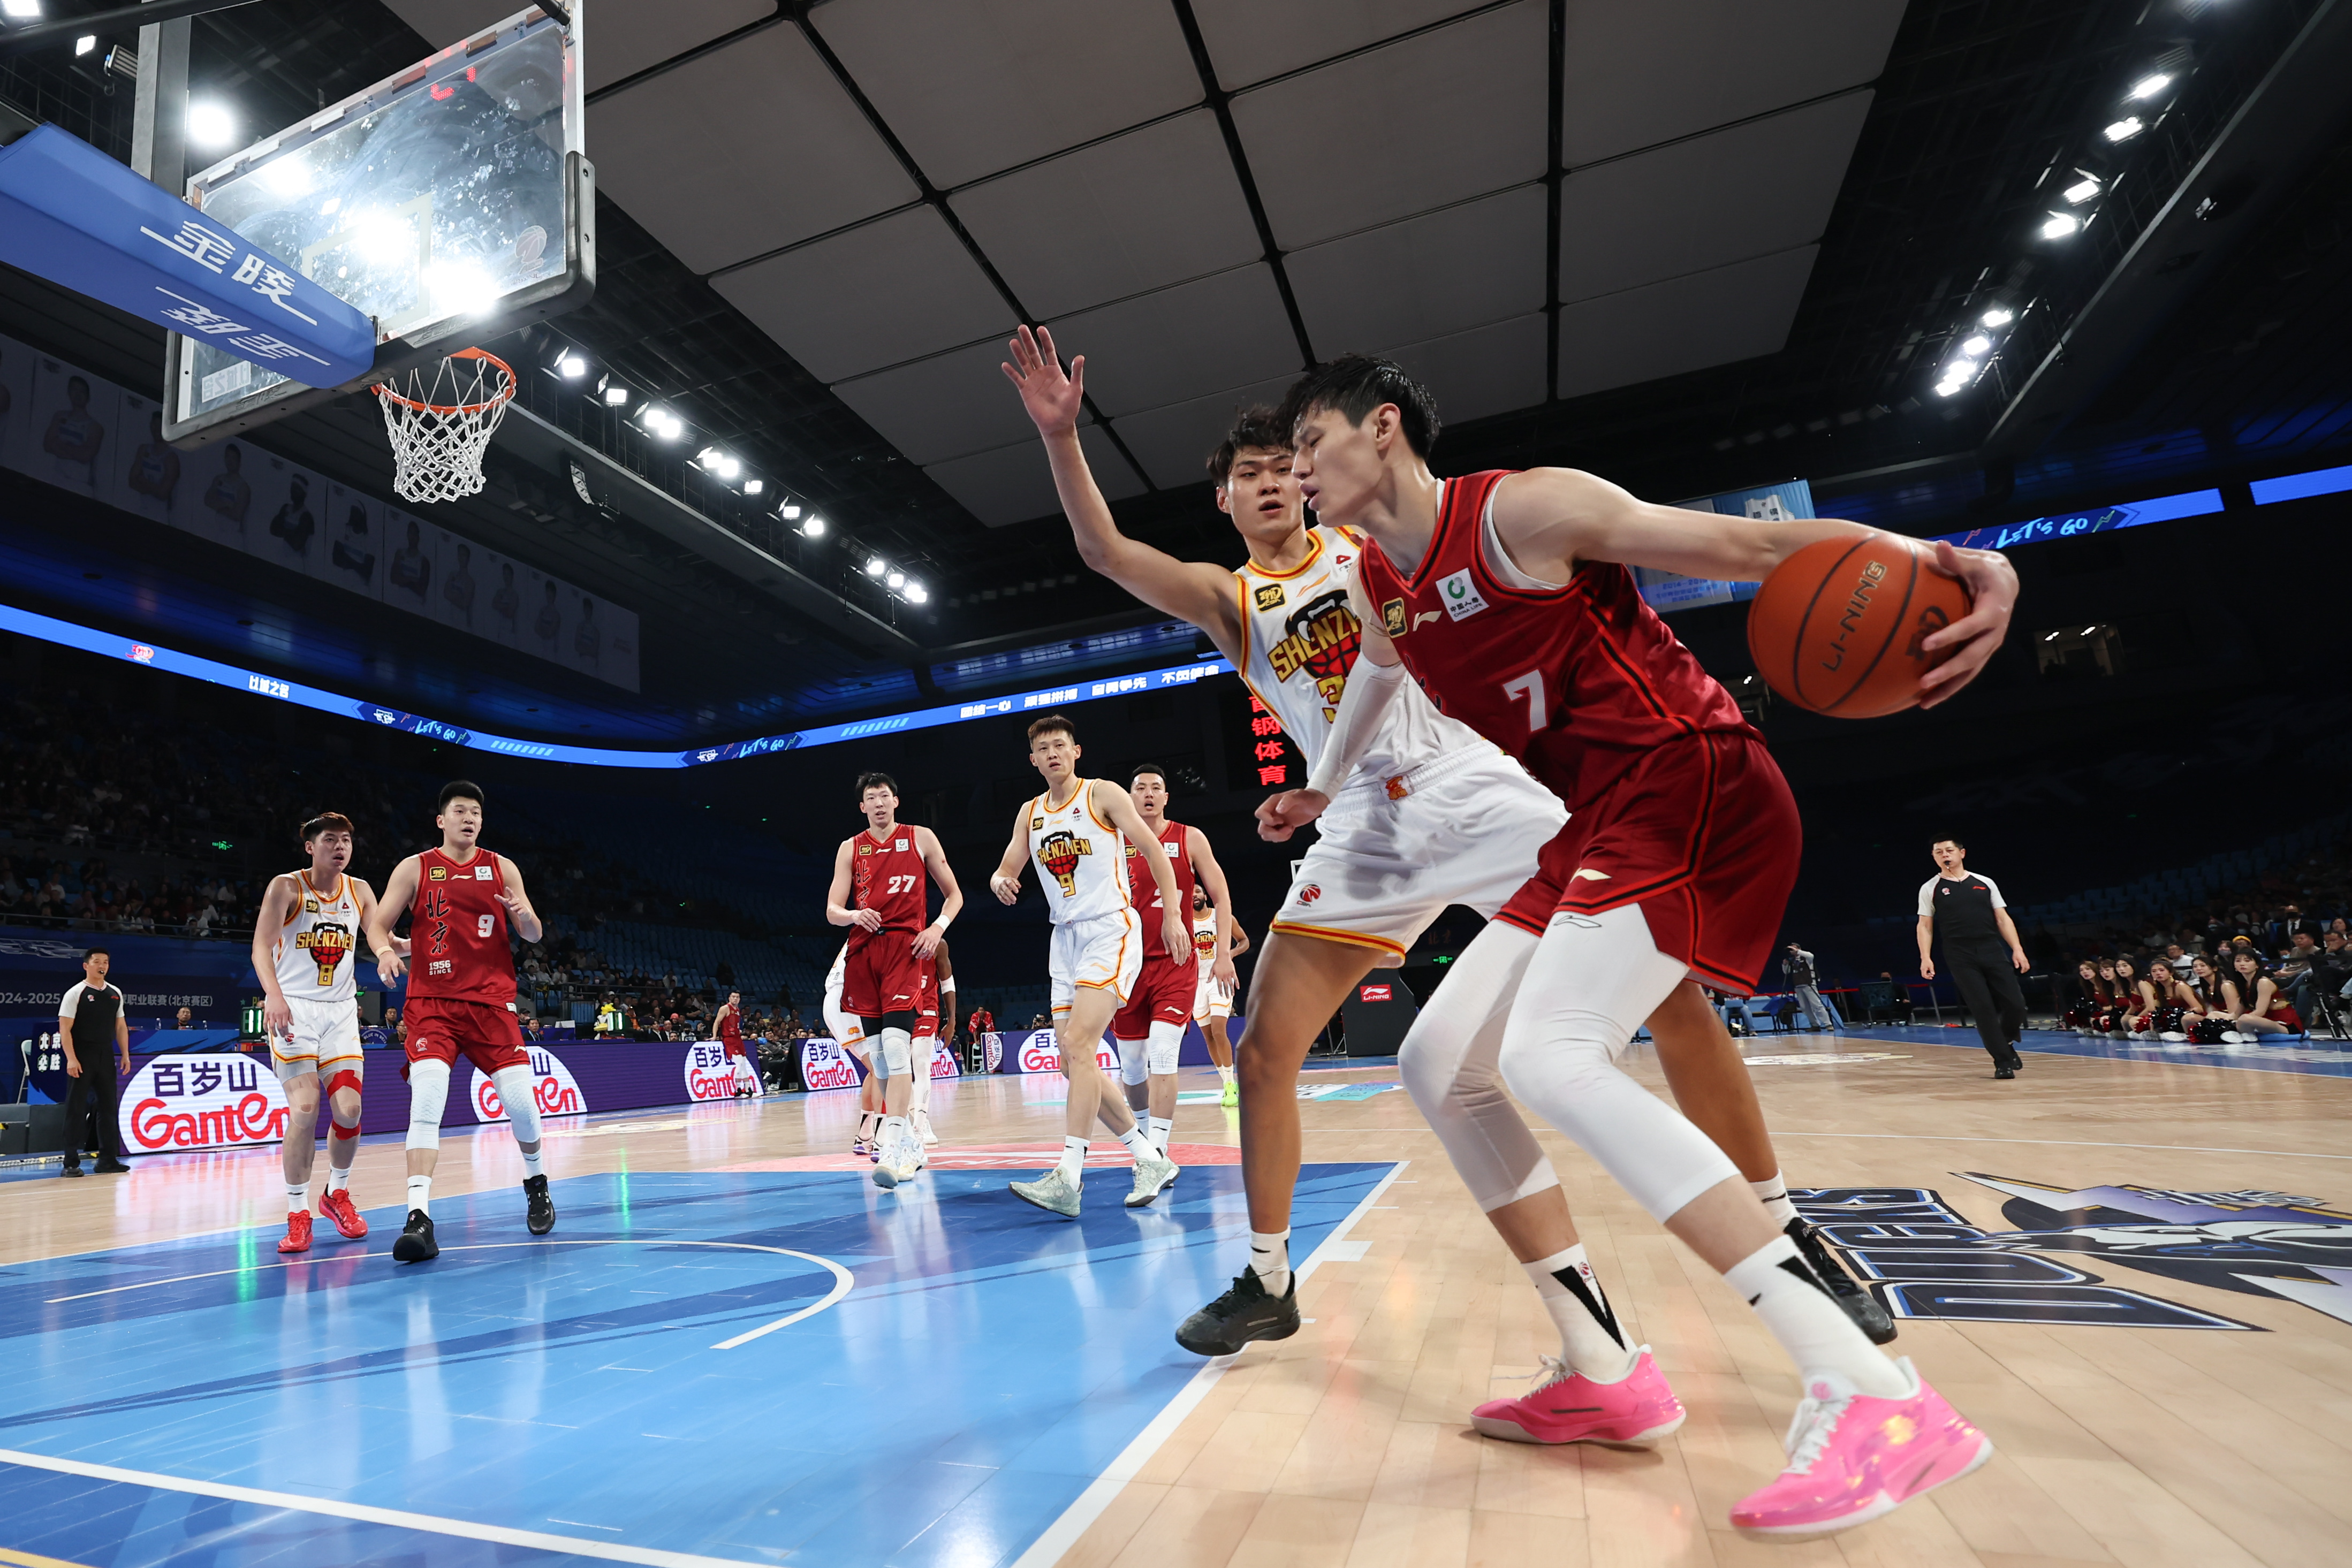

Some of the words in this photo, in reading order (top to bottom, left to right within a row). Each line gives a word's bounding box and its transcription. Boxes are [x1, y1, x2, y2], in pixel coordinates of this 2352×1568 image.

[140, 220, 317, 326] 金陵
[155, 286, 331, 366] 金陵
[1996, 517, 2054, 549] LET'S
[2060, 517, 2088, 535] GO
[1450, 596, 1479, 613] 中国人寿
[1454, 608, 1470, 618] CHINA
[1471, 602, 1483, 611] LIFE
[1822, 560, 1887, 672] LI-NING
[1267, 606, 1361, 684] SHENZ
[249, 675, 290, 699] 以城之名
[960, 699, 1012, 719] 团结一心
[1023, 687, 1079, 708] 顽强拼搏
[1161, 664, 1220, 684] 不负使命
[1503, 669, 1549, 733] 7
[443, 728, 456, 741] GO
[739, 737, 769, 758] LET'S
[770, 739, 785, 752] GO
[887, 874, 916, 895] 27
[1059, 872, 1076, 898] 9
[425, 887, 450, 955] 北京
[478, 915, 495, 938] 9
[295, 932, 354, 952] SHENZHEN
[429, 960, 451, 970] 1956
[1199, 948, 1215, 960] 32
[317, 964, 335, 986] 8
[39, 1031, 61, 1050] 北京
[807, 1042, 840, 1061] 百岁山
[37, 1053, 60, 1072] 必胜
[151, 1061, 257, 1097] 百岁山
